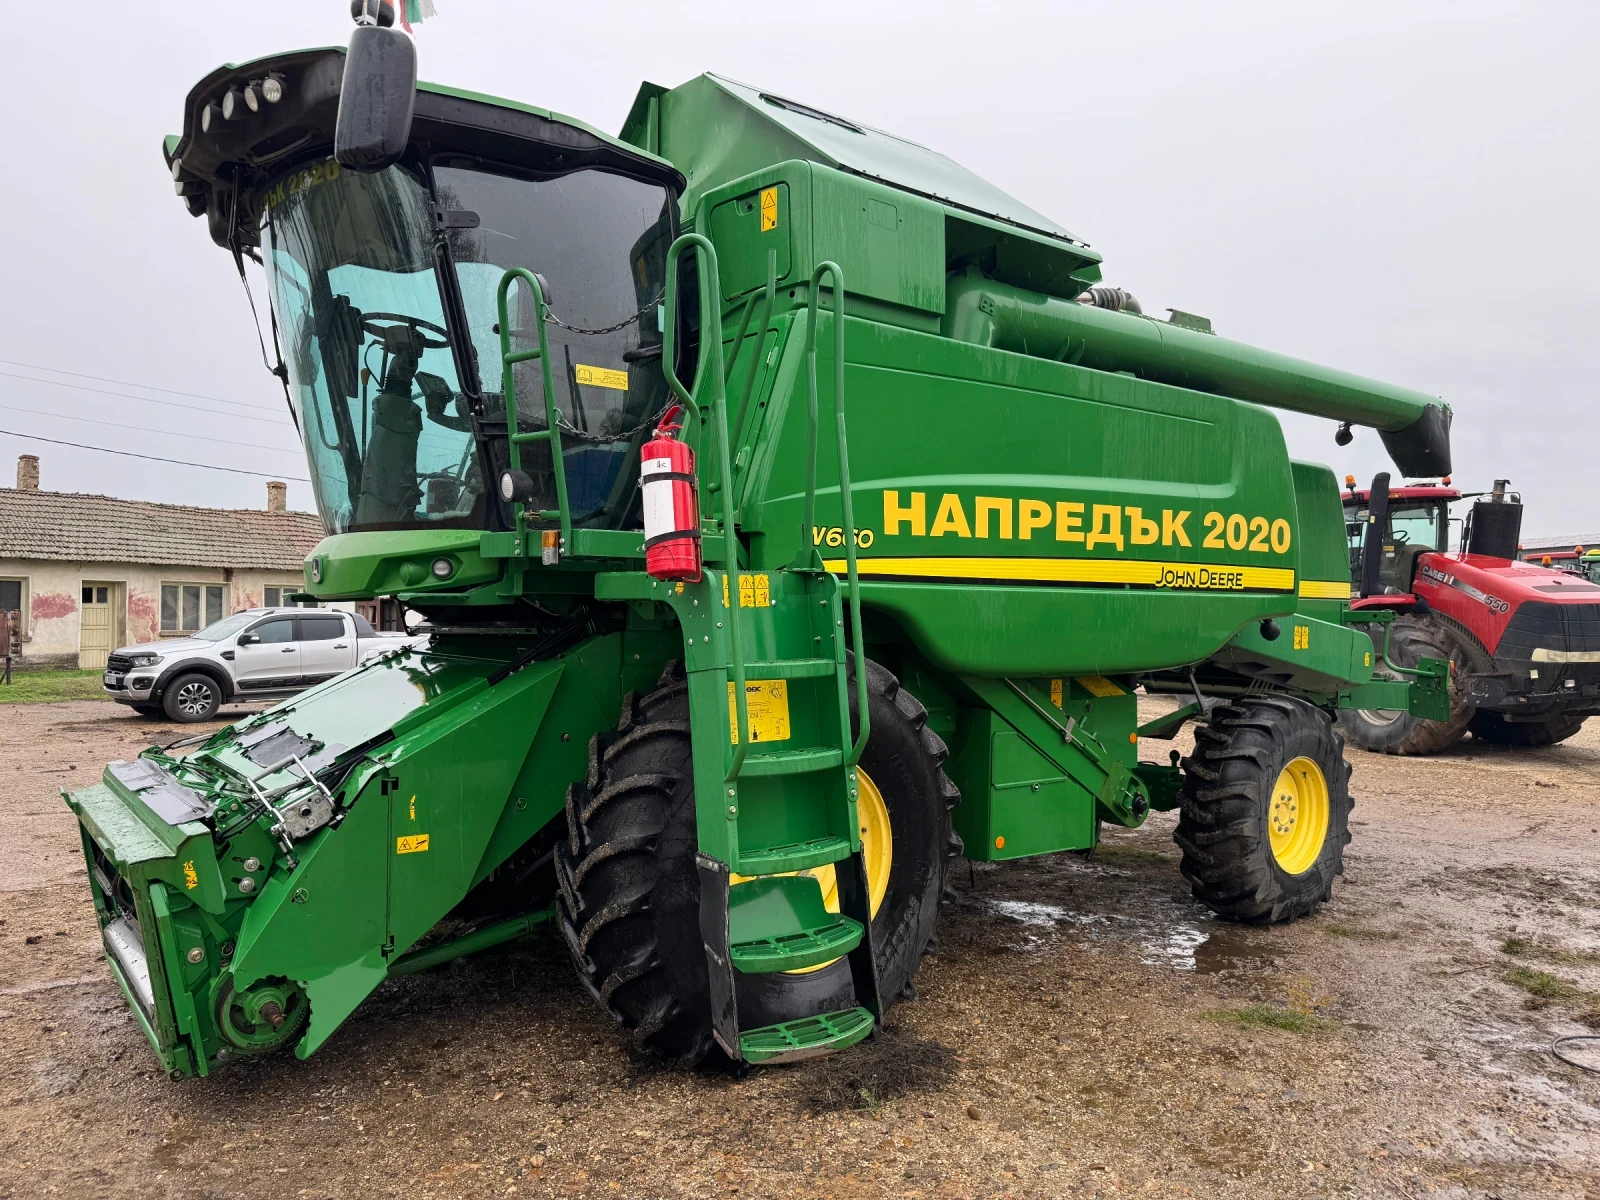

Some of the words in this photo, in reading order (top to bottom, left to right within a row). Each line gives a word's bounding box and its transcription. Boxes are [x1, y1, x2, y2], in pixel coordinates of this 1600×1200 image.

[883, 490, 1193, 552] НАПРЕДЪК
[1202, 511, 1291, 554] 2020
[1155, 566, 1196, 587] JOHN
[1198, 568, 1244, 589] DEERE
[1422, 566, 1445, 582] CASE
[1484, 594, 1510, 614] 550
